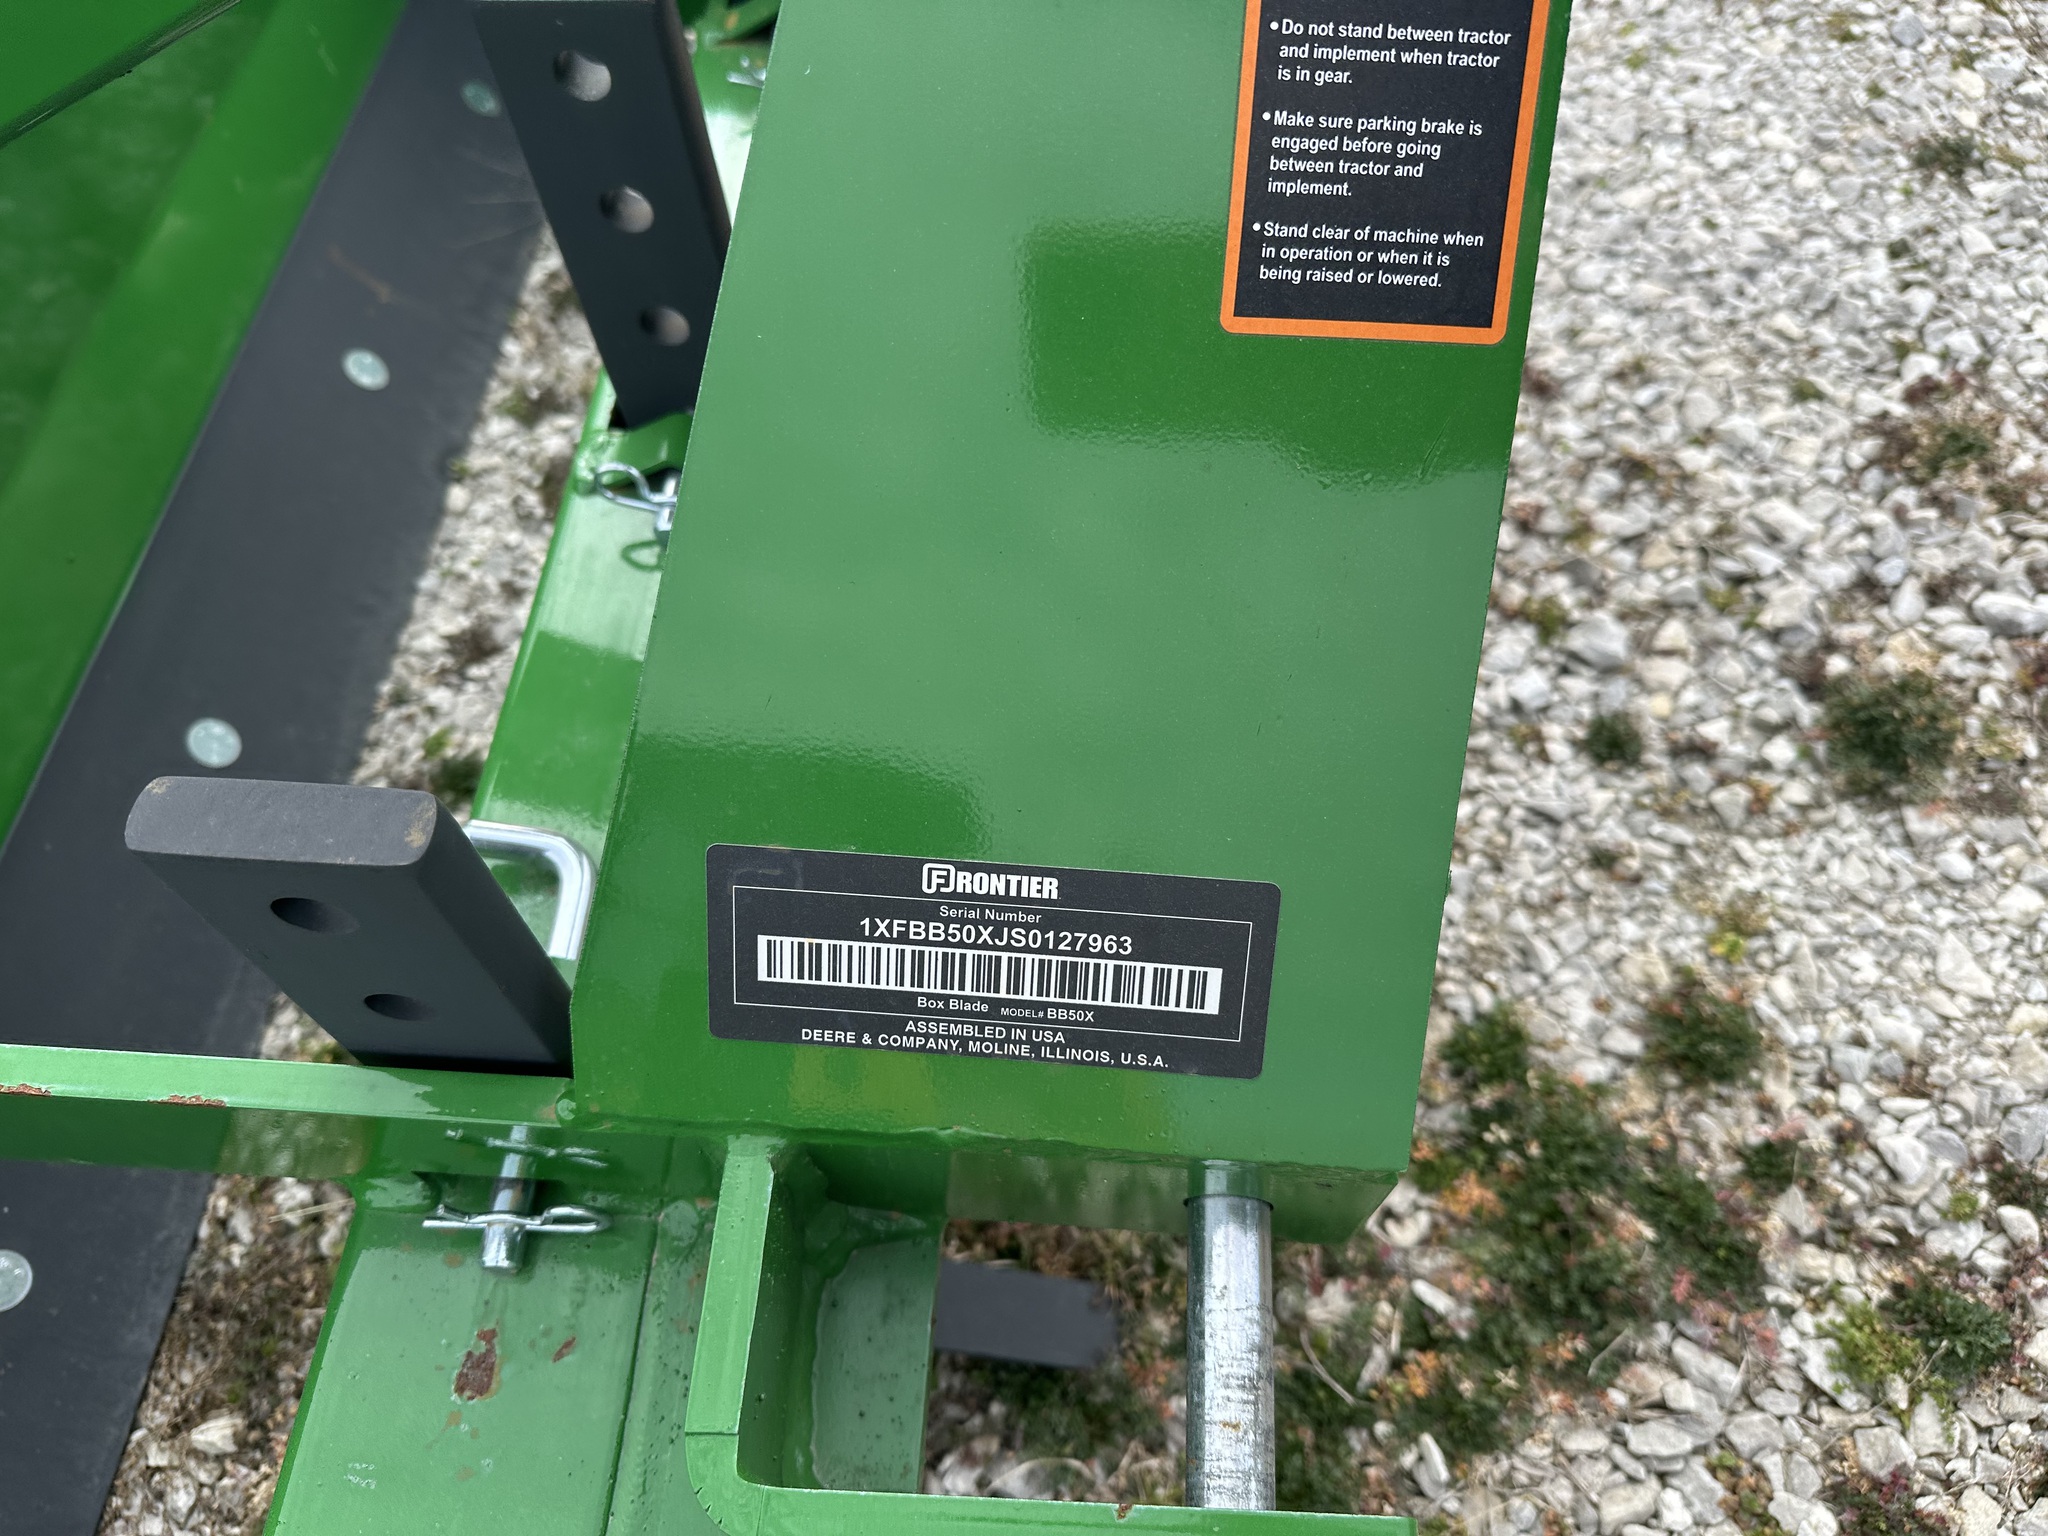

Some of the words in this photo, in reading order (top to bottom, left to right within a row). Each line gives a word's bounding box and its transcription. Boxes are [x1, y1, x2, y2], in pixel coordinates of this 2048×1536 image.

[1282, 19, 1304, 36] Do
[1308, 21, 1334, 37] not
[1338, 23, 1382, 40] stand
[1387, 26, 1453, 43] between
[1458, 29, 1511, 45] tractor
[1279, 45, 1308, 59] and
[1313, 45, 1396, 64] implement
[1401, 50, 1442, 65] when
[1447, 52, 1500, 68] tractor
[1277, 67, 1291, 81] is
[1296, 68, 1310, 82] in
[1315, 70, 1353, 86] gear.
[1274, 111, 1314, 127] Make
[1318, 116, 1353, 129] sure
[1357, 116, 1416, 135] parking
[1421, 119, 1464, 135] brake
[1469, 121, 1482, 136] is
[1272, 136, 1338, 155] engaged
[1343, 138, 1392, 154] before
[1397, 141, 1441, 159] going
[1270, 157, 1334, 173] between
[1339, 160, 1390, 176] tractor
[1394, 163, 1423, 178] and
[1268, 179, 1352, 197] implement.
[1264, 222, 1308, 239] Stand
[1312, 225, 1350, 240] clear
[1354, 226, 1370, 241] of
[1374, 228, 1438, 244] machine
[1443, 232, 1484, 247] when
[1261, 245, 1275, 259] in
[1280, 246, 1352, 264] operation
[1357, 249, 1373, 262] or
[1377, 249, 1418, 265] when
[1423, 251, 1432, 265] it
[1437, 252, 1450, 266] is
[1259, 266, 1301, 284] being
[1306, 268, 1352, 283] raised
[1357, 270, 1373, 284] or
[1378, 270, 1442, 287] lowered.
[921, 863, 1059, 900] FRONTIER
[940, 906, 980, 919] Serial
[985, 909, 1042, 923] Number
[860, 918, 1133, 955] 1XFBB50XJS0127963
[918, 997, 944, 1009] Box
[949, 999, 989, 1012] Blade
[1000, 1008, 1044, 1018] MODEL#
[1047, 1008, 1094, 1022] BB50X
[905, 1020, 1006, 1039] ASSEMBLED
[1011, 1028, 1027, 1041] IN
[1032, 1029, 1065, 1043] USA
[802, 1029, 856, 1043] DEERE
[862, 1033, 872, 1044] &
[878, 1034, 962, 1053] COMPANY,
[968, 1041, 1035, 1058] MOLINE,
[1041, 1046, 1115, 1064] ILLINOIS,
[1121, 1052, 1169, 1068] U.S.A.
